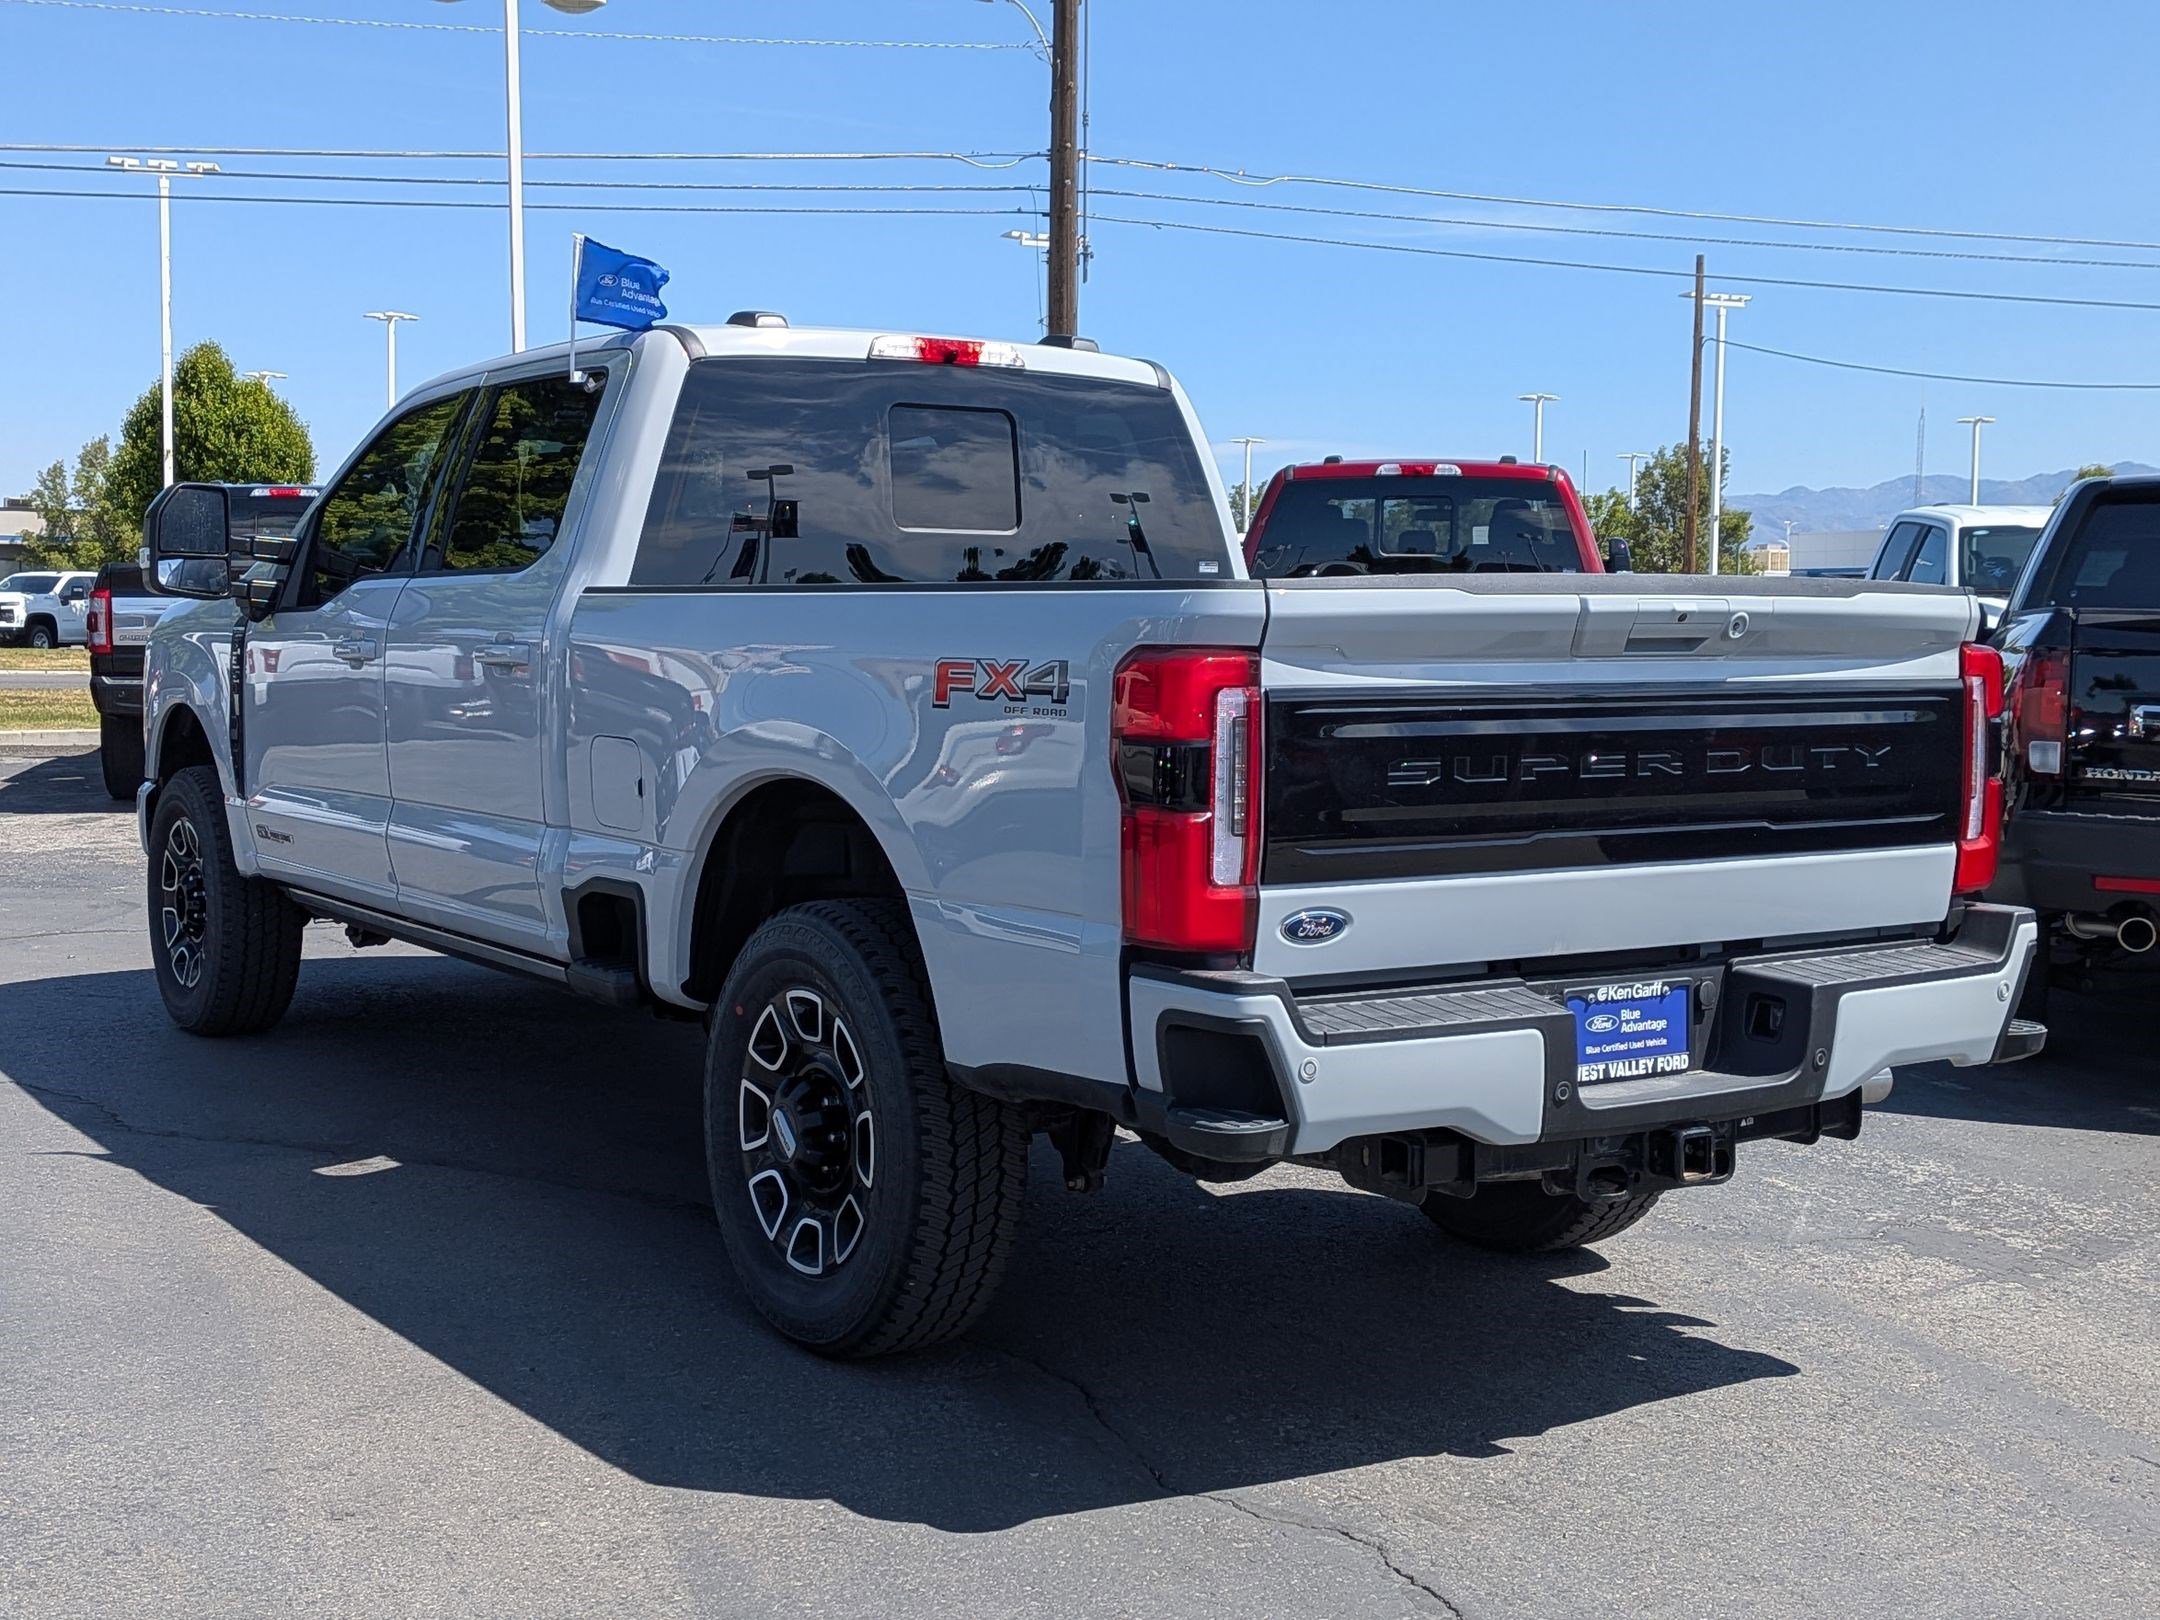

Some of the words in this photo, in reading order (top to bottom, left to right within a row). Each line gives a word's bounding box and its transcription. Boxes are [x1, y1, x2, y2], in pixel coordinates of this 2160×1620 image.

[621, 278, 640, 290] Blue
[631, 305, 646, 314] Used
[932, 657, 1070, 709] FX4
[1003, 705, 1029, 715] OFF
[1033, 707, 1067, 717] ROAD
[1387, 750, 1685, 786] SUPER
[1706, 744, 1892, 775] DUTY
[1298, 917, 1335, 937] Ford
[1608, 985, 1631, 1001] Ken
[1632, 982, 1663, 998] Garff
[1621, 1009, 1641, 1021] Blue
[1620, 1019, 1667, 1033] Advantage
[1585, 1045, 1600, 1055] Blue
[1601, 1042, 1628, 1053] Certified
[1629, 1040, 1645, 1050] Used
[1645, 1037, 1668, 1048] Vehicle
[1608, 1057, 1655, 1078] VALLEY
[1657, 1055, 1689, 1072] FORD
